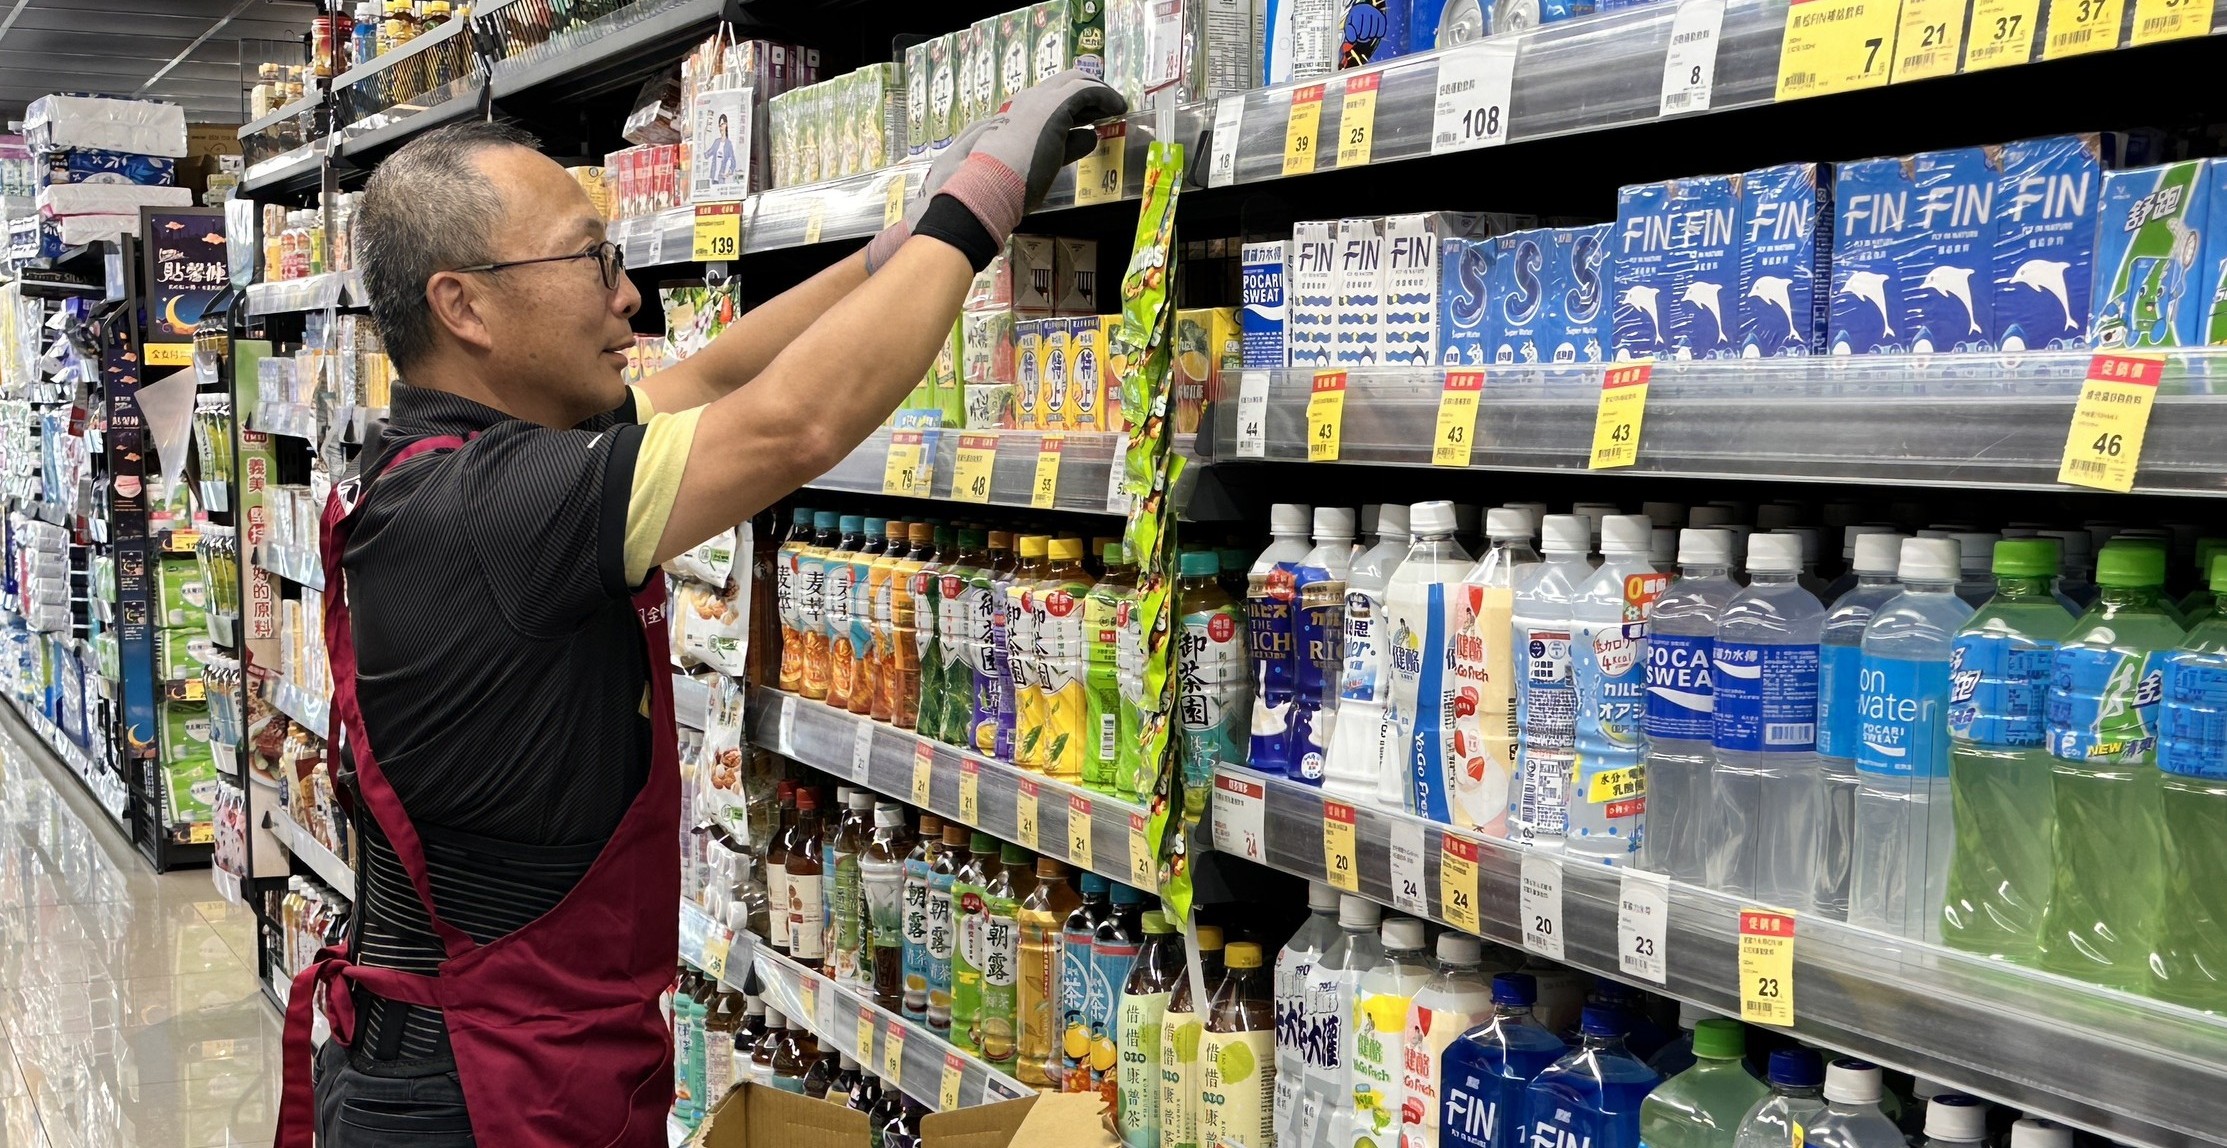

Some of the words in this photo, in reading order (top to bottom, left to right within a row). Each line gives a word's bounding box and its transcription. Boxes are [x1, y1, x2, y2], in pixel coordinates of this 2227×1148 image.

[1921, 23, 1946, 47] 21
[1993, 15, 2021, 41] 37
[1864, 38, 1883, 74] 7
[1690, 65, 1701, 84] 8
[1462, 106, 1500, 139] 108
[1296, 136, 1308, 152] 39
[1350, 128, 1364, 144] 25
[1219, 153, 1230, 169] 18
[1102, 170, 1118, 192] 49
[1917, 182, 1993, 229] FIN
[2007, 171, 2091, 222] FIN
[1843, 191, 1907, 235] FIN
[2124, 184, 2183, 232] 舒跑
[1682, 207, 1734, 248] FIN
[1747, 199, 1810, 242] FIN
[1622, 214, 1672, 253] FIN
[711, 237, 734, 255] 139
[1343, 240, 1380, 270] FIN
[1390, 236, 1432, 269] FIN
[1299, 243, 1334, 272] FIN
[1243, 274, 1283, 290] POCARI
[1450, 248, 1488, 329] S
[1503, 239, 1542, 326] S
[1564, 234, 1602, 324] S
[1243, 289, 1281, 304] SWEAT
[1246, 421, 1258, 437] 44
[1319, 423, 1333, 439] 43
[1447, 426, 1463, 443] 43
[1612, 423, 1631, 442] 43
[2092, 432, 2123, 457] 46
[902, 469, 913, 490] 79
[971, 476, 985, 496] 48
[1252, 620, 1272, 630] THE
[1863, 722, 1905, 736] POCARI
[1863, 733, 1899, 744] SWEAT
[1414, 732, 1426, 779] YoGo
[2087, 742, 2123, 757] NEW
[918, 780, 925, 792] 21
[1024, 818, 1032, 832] 21
[1076, 837, 1085, 851] 21
[1246, 837, 1257, 857] 24
[1139, 859, 1149, 871] 21
[1336, 855, 1348, 871] 20
[1403, 880, 1417, 896] 24
[1453, 890, 1468, 908] 24
[906, 881, 926, 943] 朝露
[929, 895, 949, 954] 朝露
[1535, 916, 1552, 935] 20
[986, 920, 1009, 980] 朝露
[1636, 937, 1654, 956] 23
[1759, 977, 1779, 997] 23
[1126, 1005, 1140, 1048] 惜惜
[1127, 1067, 1140, 1128] 康普茶
[1446, 1088, 1496, 1141] FIN
